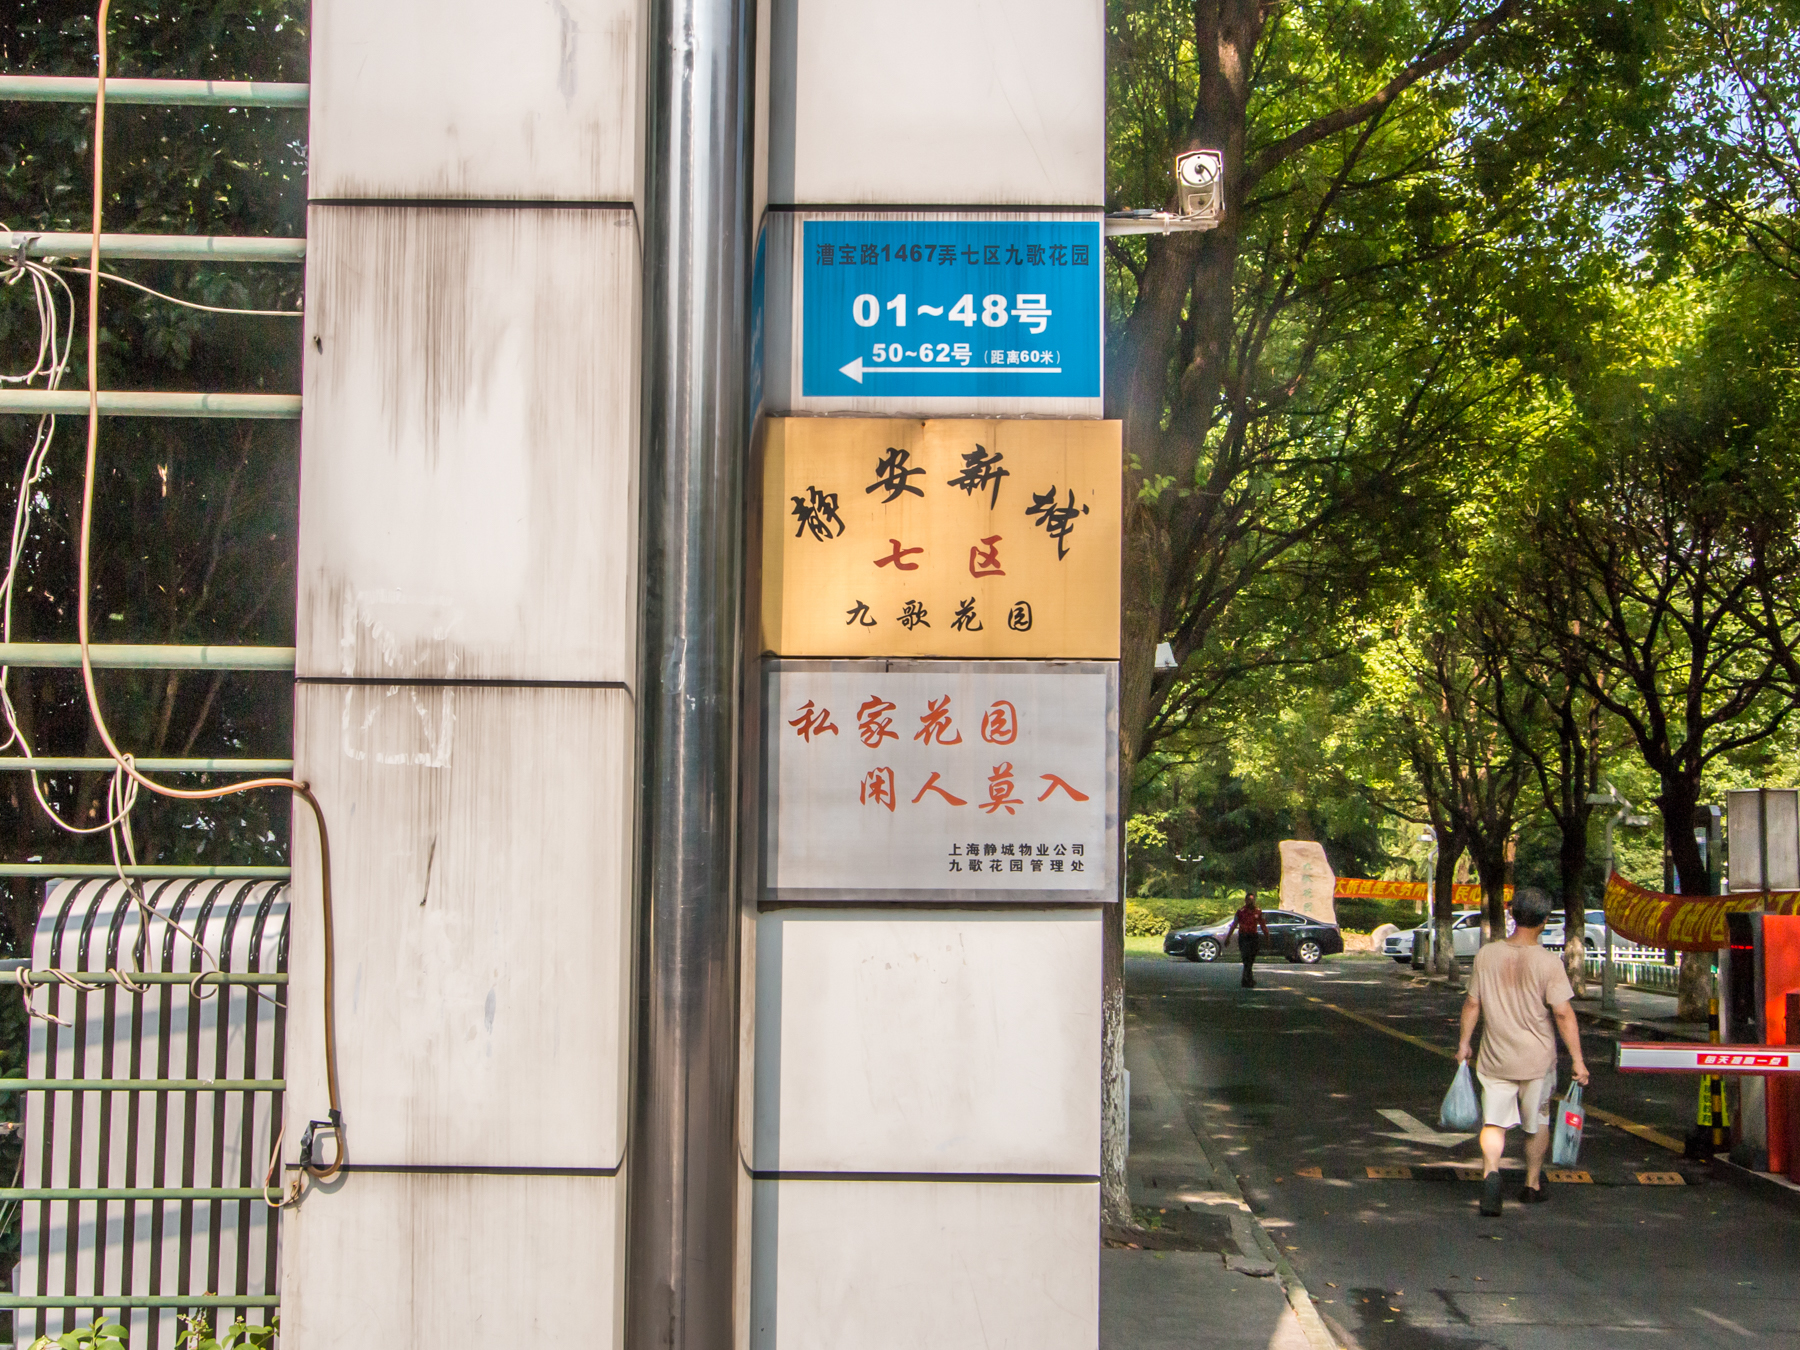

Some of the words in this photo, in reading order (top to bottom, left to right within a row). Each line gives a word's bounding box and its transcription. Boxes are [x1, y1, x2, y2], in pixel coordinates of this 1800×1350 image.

[815, 243, 1090, 266] 漕宝路1467弄七区九歌花园
[852, 293, 1053, 335] 01~48号
[872, 343, 973, 366] 50~62号
[873, 534, 1006, 579] 七区
[846, 597, 1033, 632] 九歌花园
[788, 694, 1018, 749] 私家花园
[859, 761, 1090, 816] 闲人莫入
[948, 842, 1085, 857] 上海静城物业公司
[948, 858, 1085, 873] 九歌花园管理处
